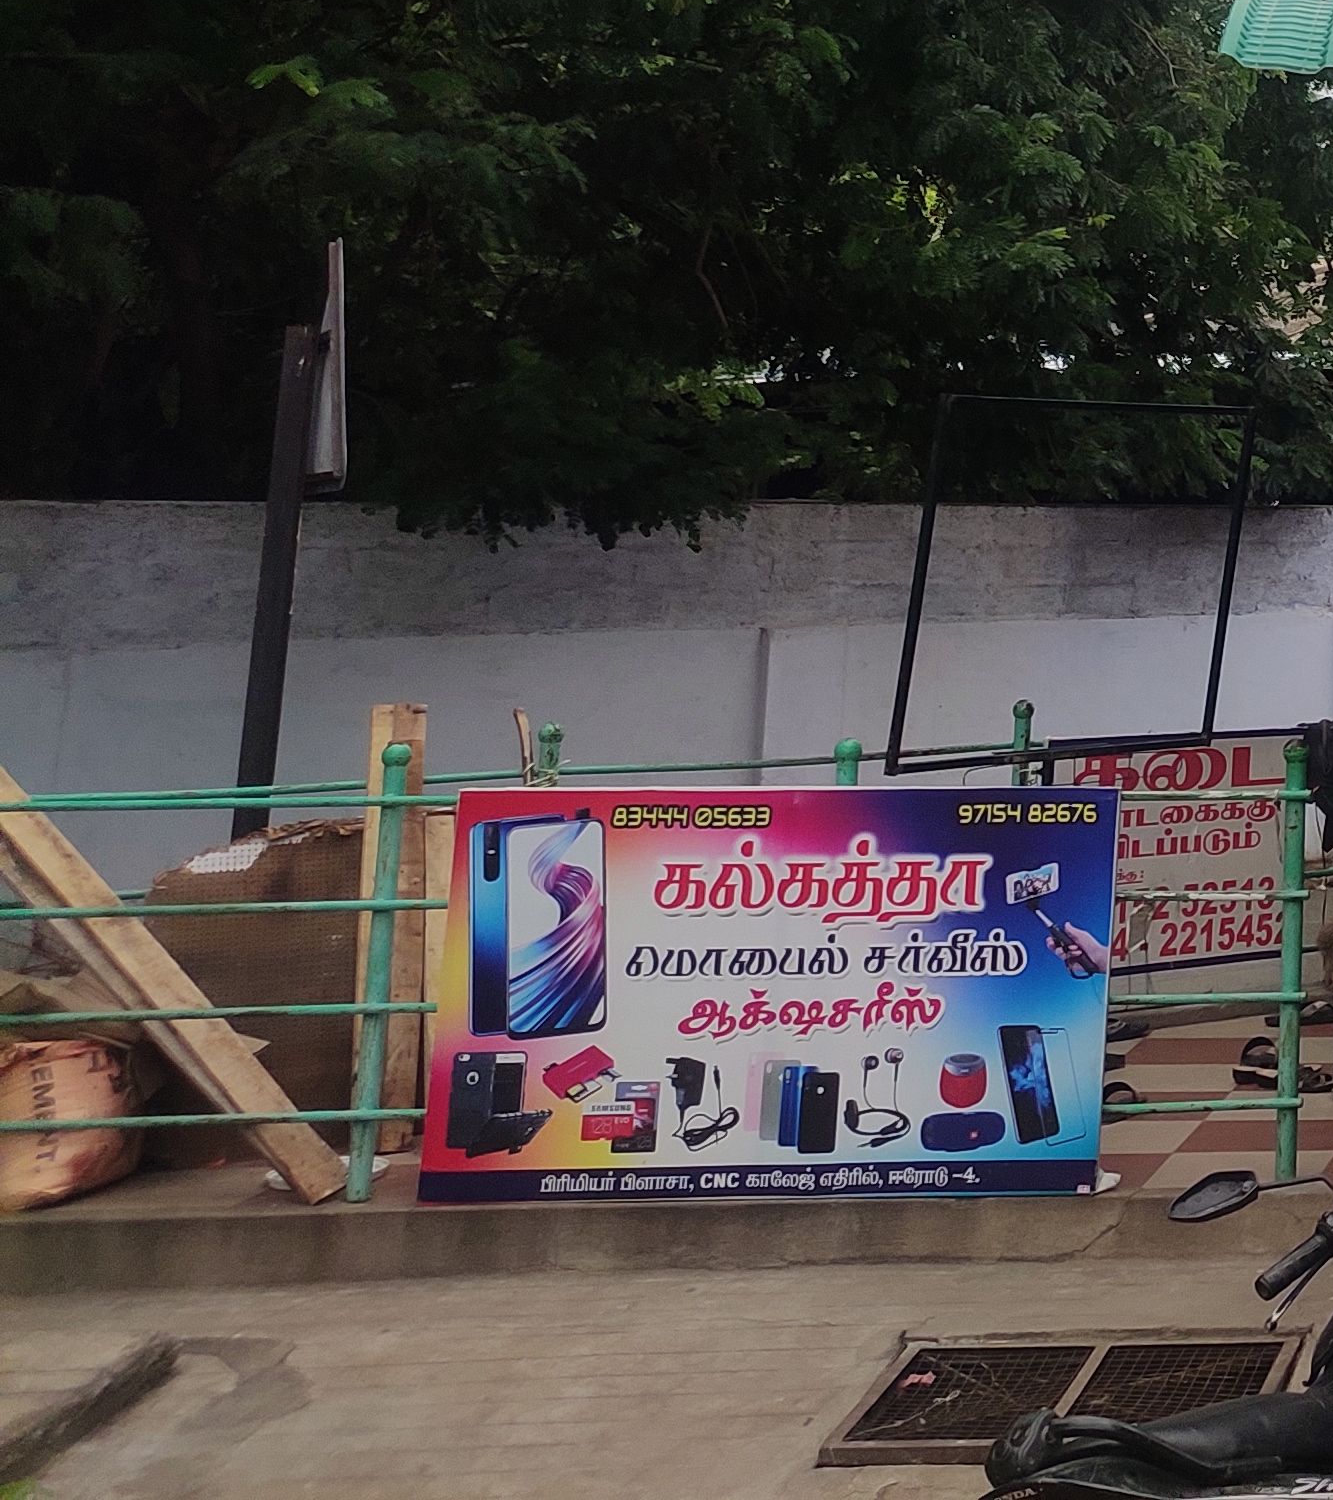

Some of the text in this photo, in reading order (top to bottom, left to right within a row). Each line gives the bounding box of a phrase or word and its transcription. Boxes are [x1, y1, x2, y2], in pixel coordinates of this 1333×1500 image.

[612, 806, 771, 828] 83444 05633
[958, 804, 1097, 824] 97154 82676
[653, 840, 988, 922] கல்கத்தா
[626, 932, 1027, 977] மொபைல் சர்வீஸ்
[591, 1104, 632, 1112] SAMSUNG
[700, 1172, 740, 1188] CNC
[745, 1168, 817, 1191] காலேஜ்
[888, 1166, 950, 1189] ஈரோடு
